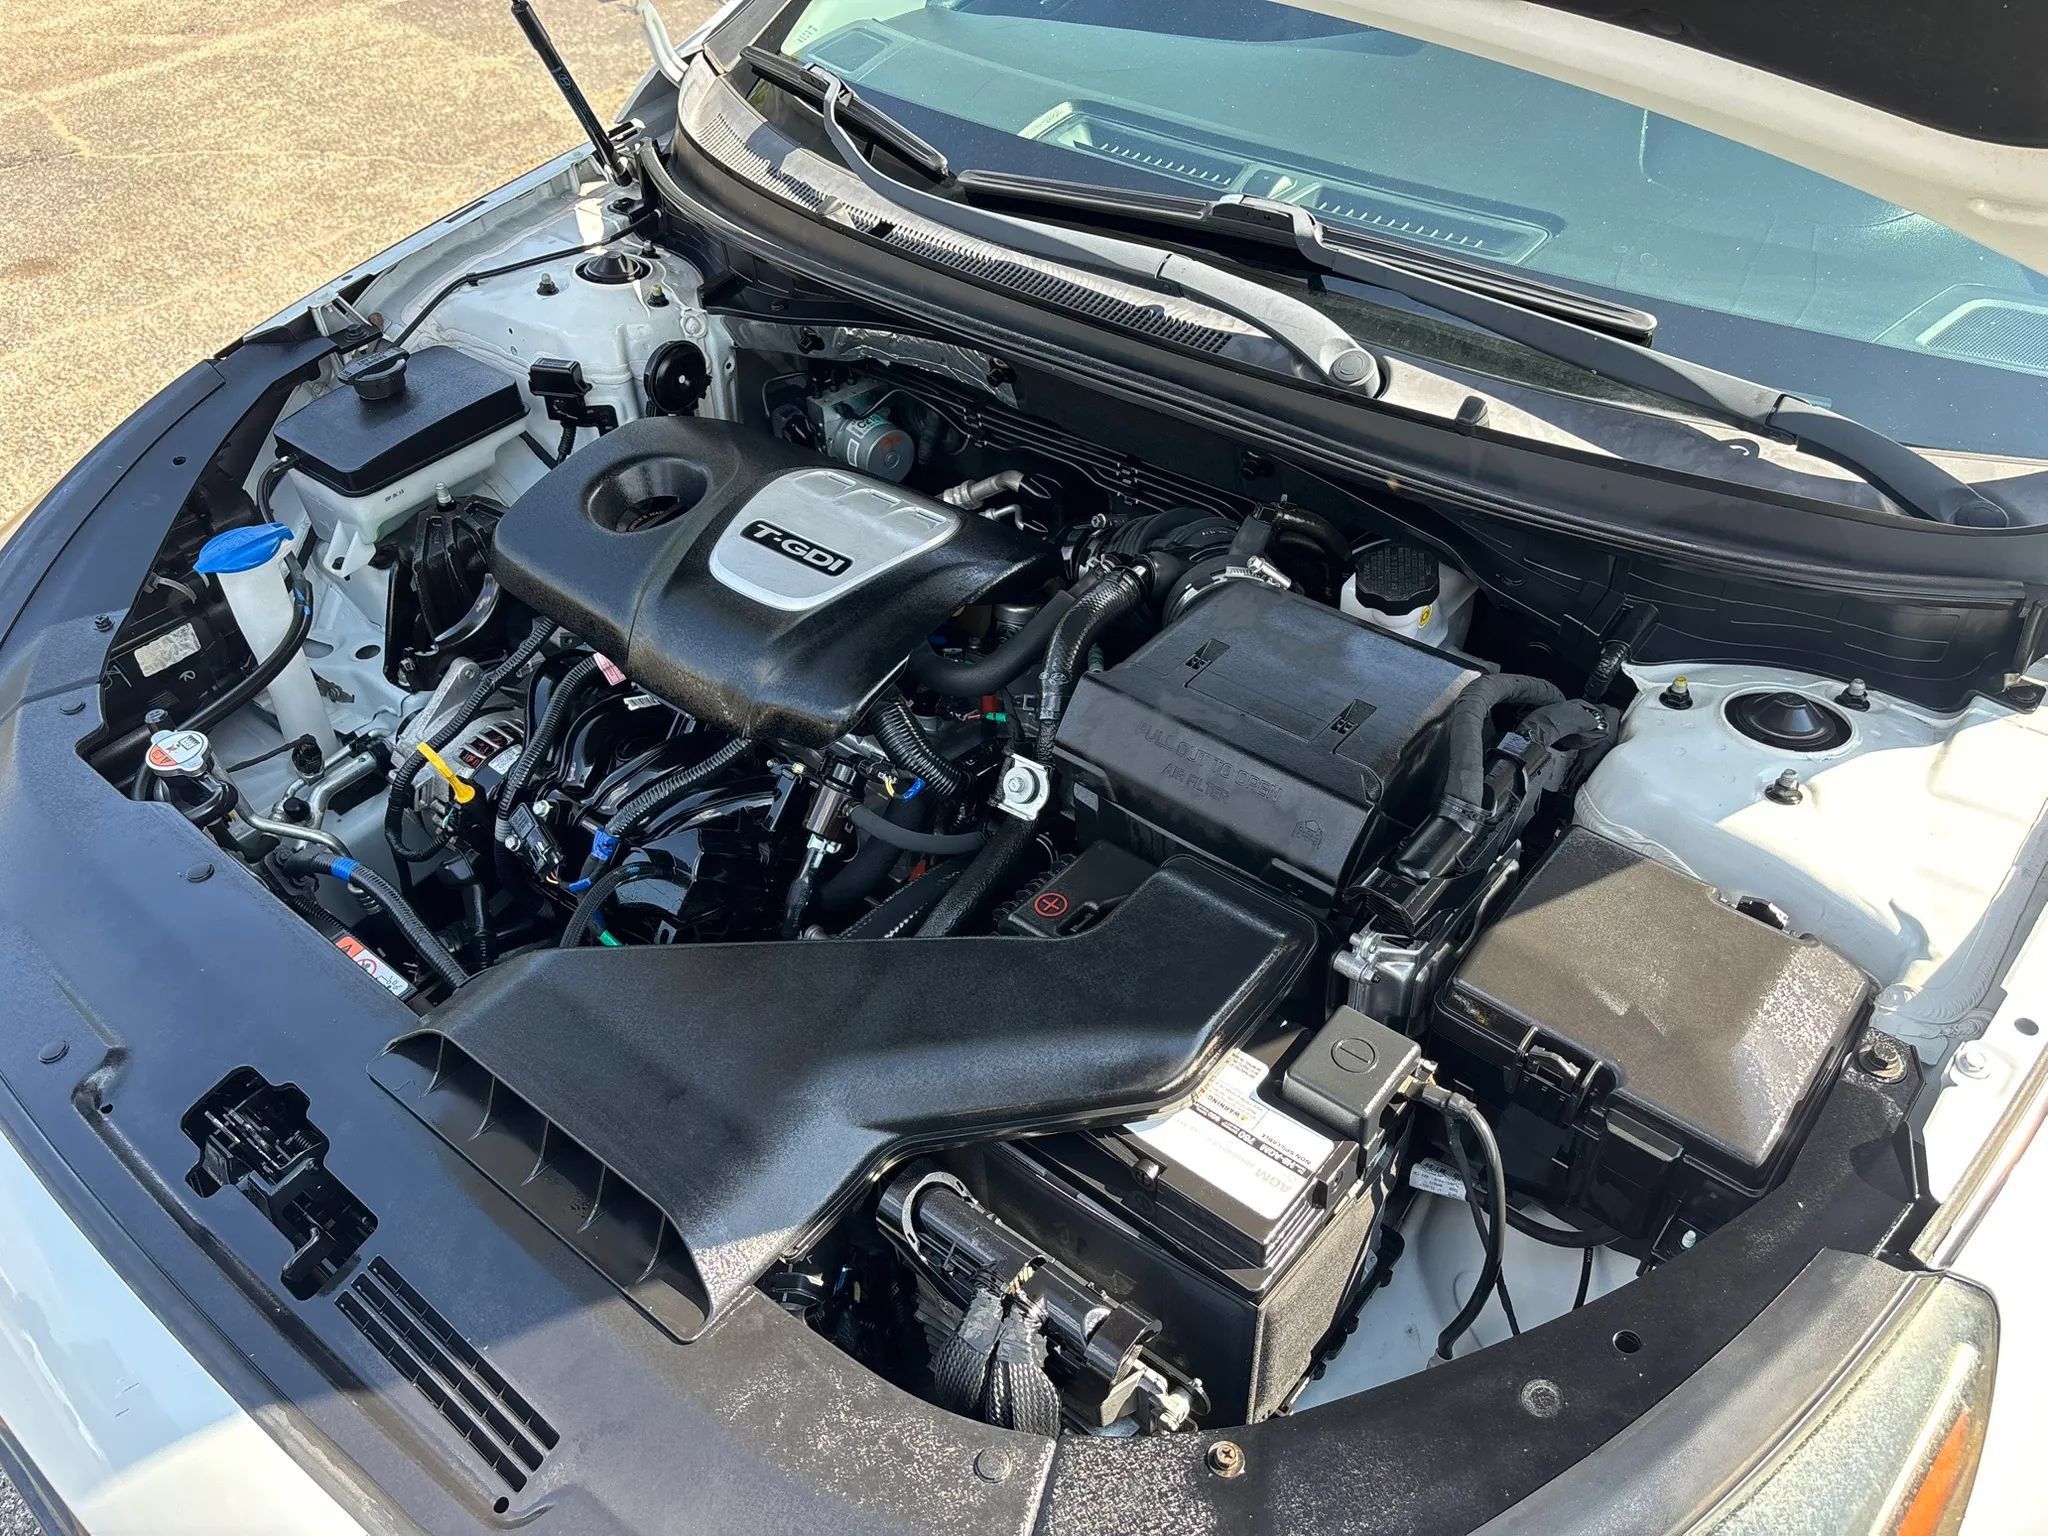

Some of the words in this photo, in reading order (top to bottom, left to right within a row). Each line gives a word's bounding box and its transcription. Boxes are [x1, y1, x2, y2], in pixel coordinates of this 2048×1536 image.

[1134, 720, 1172, 751] PULL
[1175, 741, 1211, 768] OUT
[1213, 757, 1234, 780] TO
[1234, 769, 1283, 803] OPEN
[1161, 762, 1186, 784] AIR
[1186, 773, 1231, 803] FILTER
[1207, 1094, 1240, 1118] WARNING
[1262, 1133, 1295, 1156] SPILLABLE
[1295, 1153, 1312, 1165] NON
[1255, 1168, 1293, 1193] AGM
